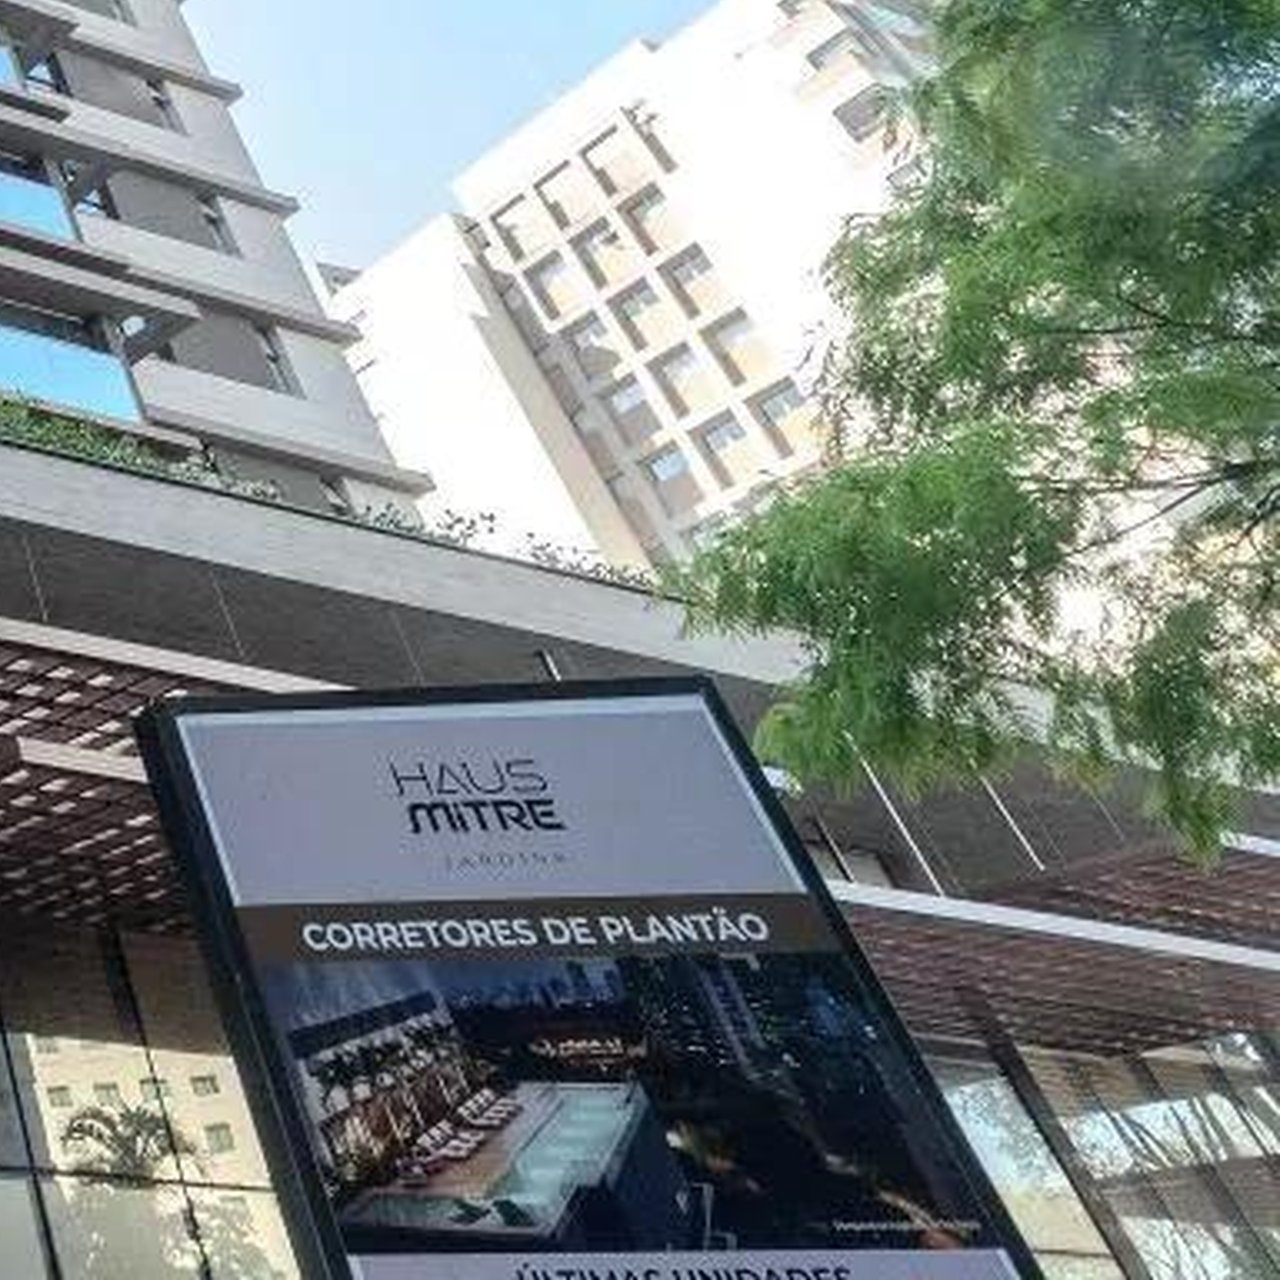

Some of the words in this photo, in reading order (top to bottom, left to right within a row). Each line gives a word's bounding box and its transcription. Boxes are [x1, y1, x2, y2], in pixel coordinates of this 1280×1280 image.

[388, 758, 548, 796] HAUS
[407, 798, 567, 834] MITRE
[302, 918, 539, 951] CORRETORES
[541, 916, 598, 945] DE
[599, 905, 769, 944] PLANTÃO
